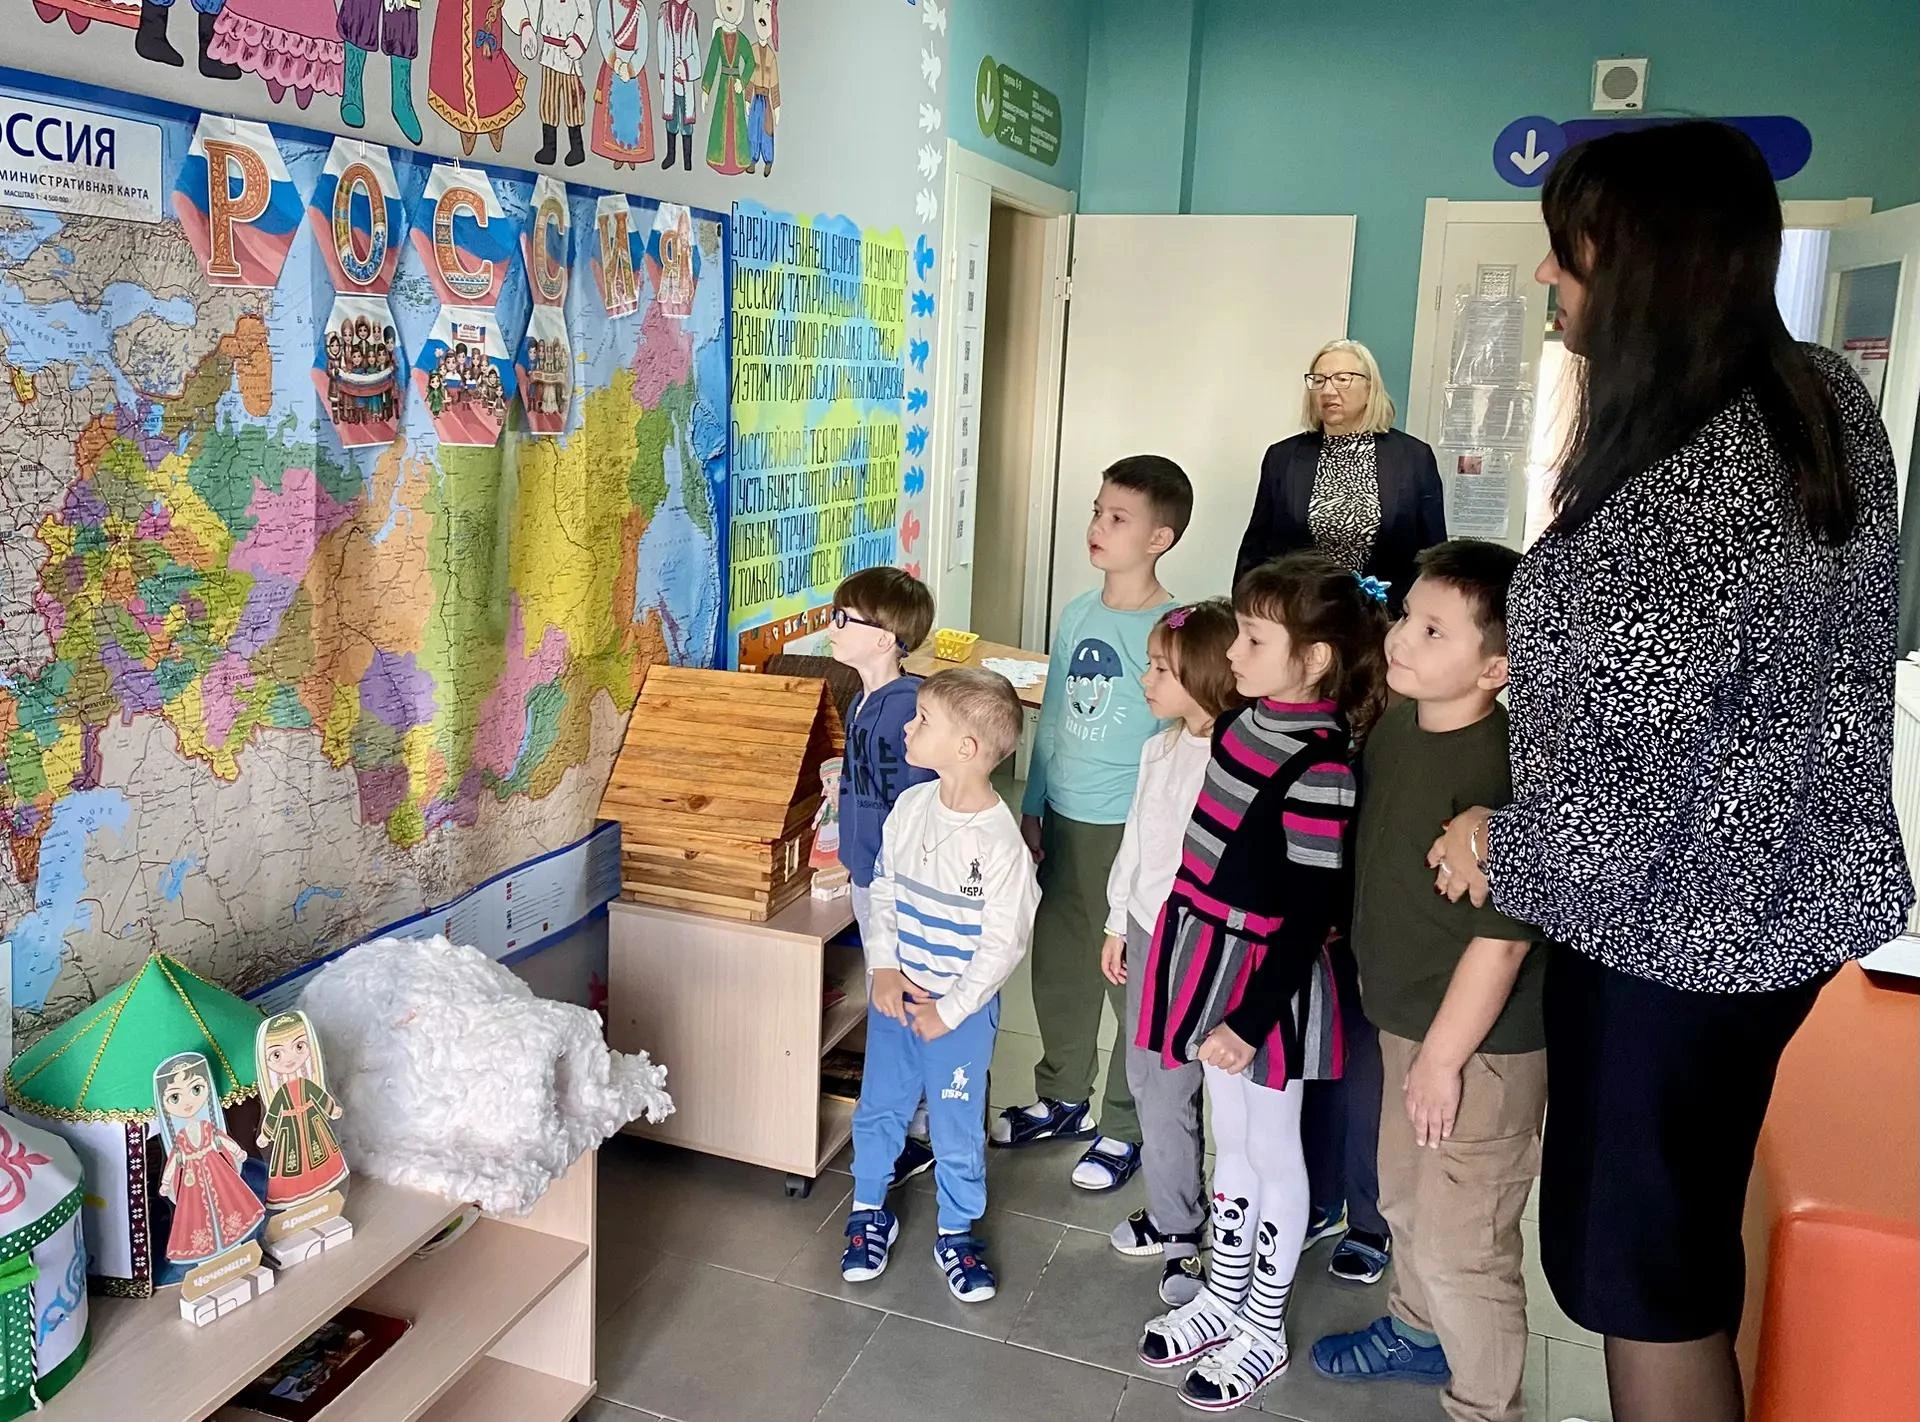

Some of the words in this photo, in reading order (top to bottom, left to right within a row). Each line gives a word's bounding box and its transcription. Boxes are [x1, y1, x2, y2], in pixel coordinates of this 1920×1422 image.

[0, 112, 115, 170] ССИЯ
[4, 189, 35, 200] МАСШТАБ
[117, 185, 149, 200] КАРТА
[731, 201, 768, 261] ЕВРЕЙ
[770, 221, 779, 262] И
[780, 222, 831, 275] ТУВИНЕЦ,
[832, 233, 862, 276] БУРЯТ
[865, 242, 873, 278] И
[832, 278, 869, 319] БАШКИР
[870, 284, 878, 320] И
[731, 310, 775, 357] РАЗНЫХ
[777, 319, 819, 360] НАРОДОВ
[821, 322, 863, 361] БОЛЬШАЯ
[729, 358, 741, 404] И
[741, 362, 772, 402] ЭТИМ
[774, 363, 828, 403] ГОРДИТЬСЯ
[828, 364, 865, 404] ДОЛЖНЫ
[731, 420, 782, 472] РОССИЕЙ
[830, 419, 862, 463] ОБЩИЙ
[730, 473, 765, 517] ПУСТЬ
[766, 473, 798, 513] БУДЕТ
[798, 467, 830, 509] УЮТНО
[831, 465, 871, 503] КАЖДОМУ
[872, 463, 878, 497] В
[729, 520, 766, 566] ЛЮБЫЕ
[767, 518, 784, 557] МЫ
[784, 507, 836, 554] ТРУДНОСТИ
[728, 566, 737, 612] И
[738, 562, 776, 608] ТОЛЬКО
[777, 560, 786, 599] В
[787, 548, 832, 596] ЕДИНСТВЕ
[834, 543, 856, 580] СИЛА
[941, 1088, 970, 1102] USPA
[193, 1253, 252, 1288] Чеченцы
